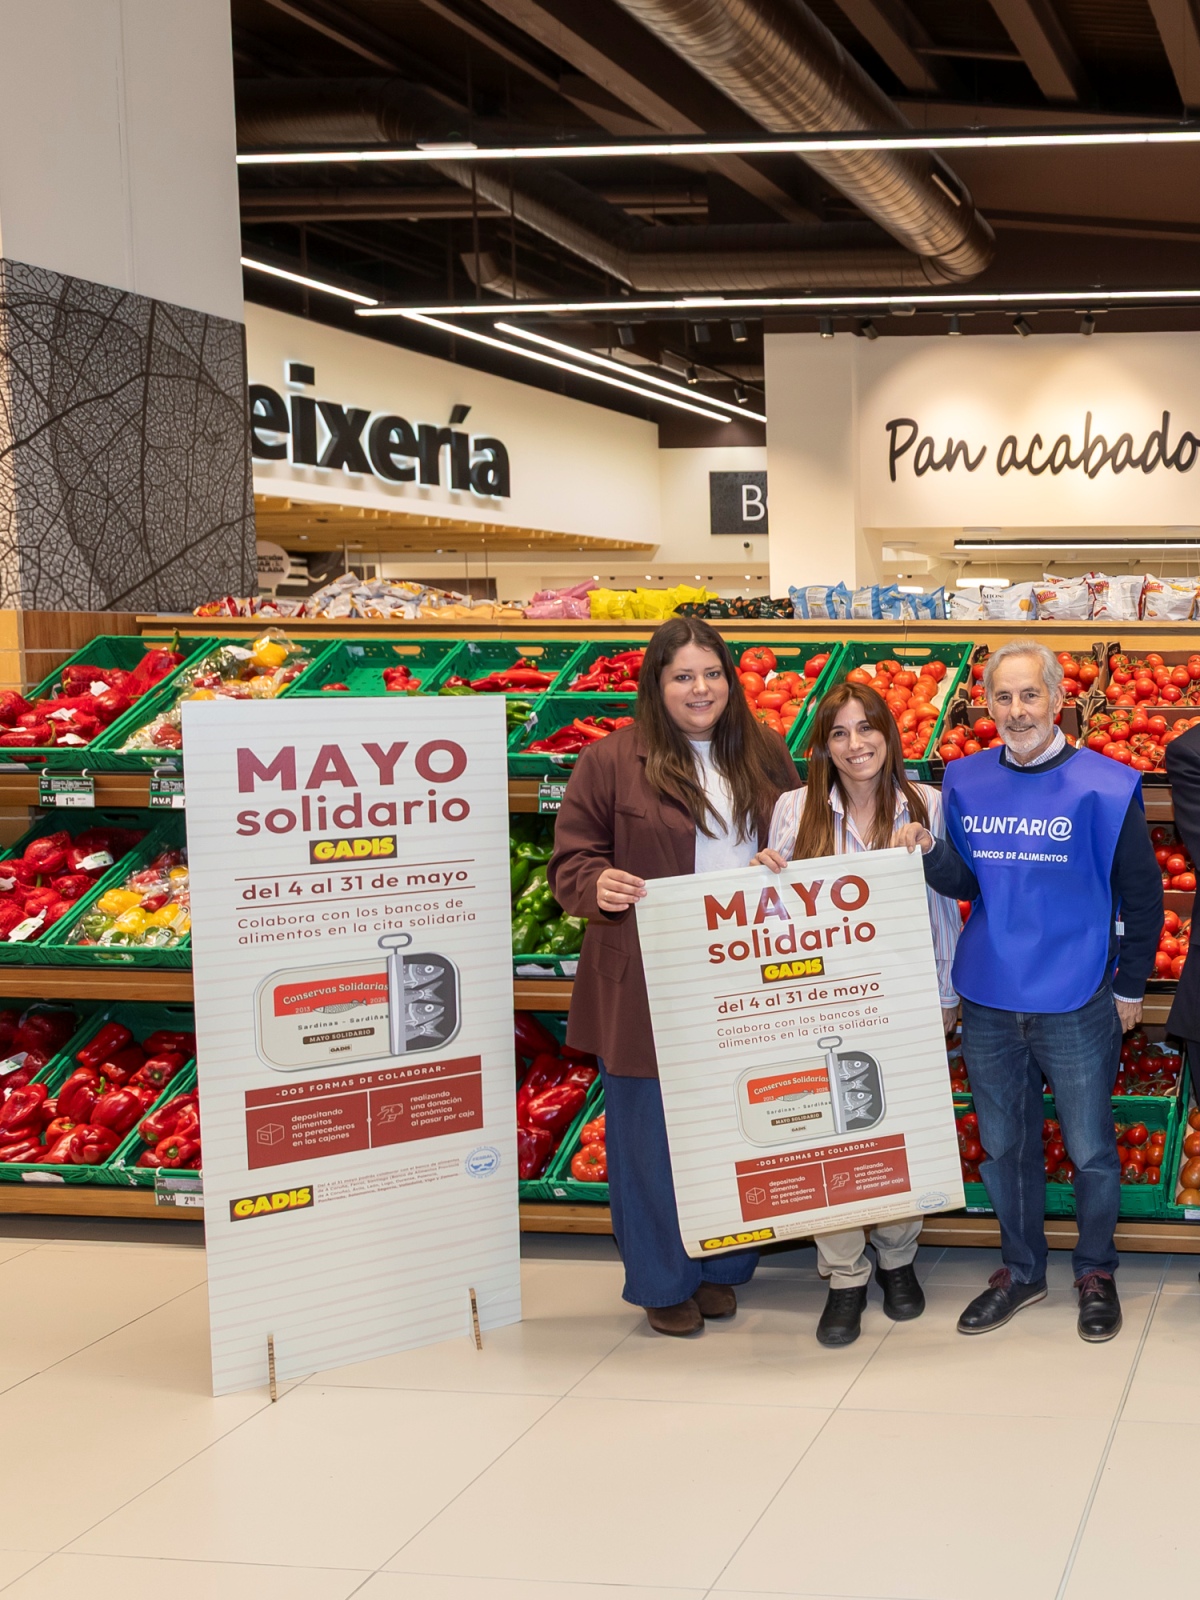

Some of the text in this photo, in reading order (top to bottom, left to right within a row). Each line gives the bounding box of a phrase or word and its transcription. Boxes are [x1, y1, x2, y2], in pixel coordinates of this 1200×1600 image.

[885, 417, 987, 483] Pan
[742, 484, 768, 521] B
[237, 739, 467, 792] MAYO
[236, 789, 470, 836] solidario
[961, 815, 1072, 841] OLUNTARI@
[313, 836, 395, 860] GADIS
[973, 850, 1068, 863] BANCOS DE ALIMENTOS
[242, 870, 467, 900] del 4 al 31 de mayo
[237, 898, 462, 928] Colabora con los bancos de
[704, 874, 869, 929] MAYO
[238, 911, 475, 944] alimentos en la cita solidaria
[708, 916, 875, 964] solidario
[764, 958, 822, 980] GADIS
[282, 986, 337, 1005] Conservas
[717, 982, 879, 1013] del 4 al 31 de mayo
[716, 1005, 877, 1036] Colabora con los bancos de
[718, 1015, 888, 1048] alimentos en la cita solidaria
[310, 1029, 371, 1042] MAYO SOLIDARIO
[276, 1086, 303, 1096] -DOS
[309, 1079, 353, 1091] FORMAS
[377, 1065, 445, 1080] COLABORAR-
[754, 1080, 791, 1095] Conservas
[410, 1090, 450, 1102] realizando
[426, 1097, 461, 1107] donación
[291, 1108, 342, 1121] depositando
[291, 1118, 332, 1130] alimentos
[410, 1106, 452, 1118] económica
[420, 1116, 441, 1125] pasar
[443, 1113, 456, 1121] por
[304, 1123, 354, 1137] perecederos
[318, 1132, 349, 1142] cajones
[756, 1158, 776, 1166] -DOS
[779, 1152, 811, 1162] FORMAS
[827, 1141, 877, 1154] COLABORAR-
[234, 1188, 311, 1215] GADIS
[704, 1230, 774, 1249] GADIS
